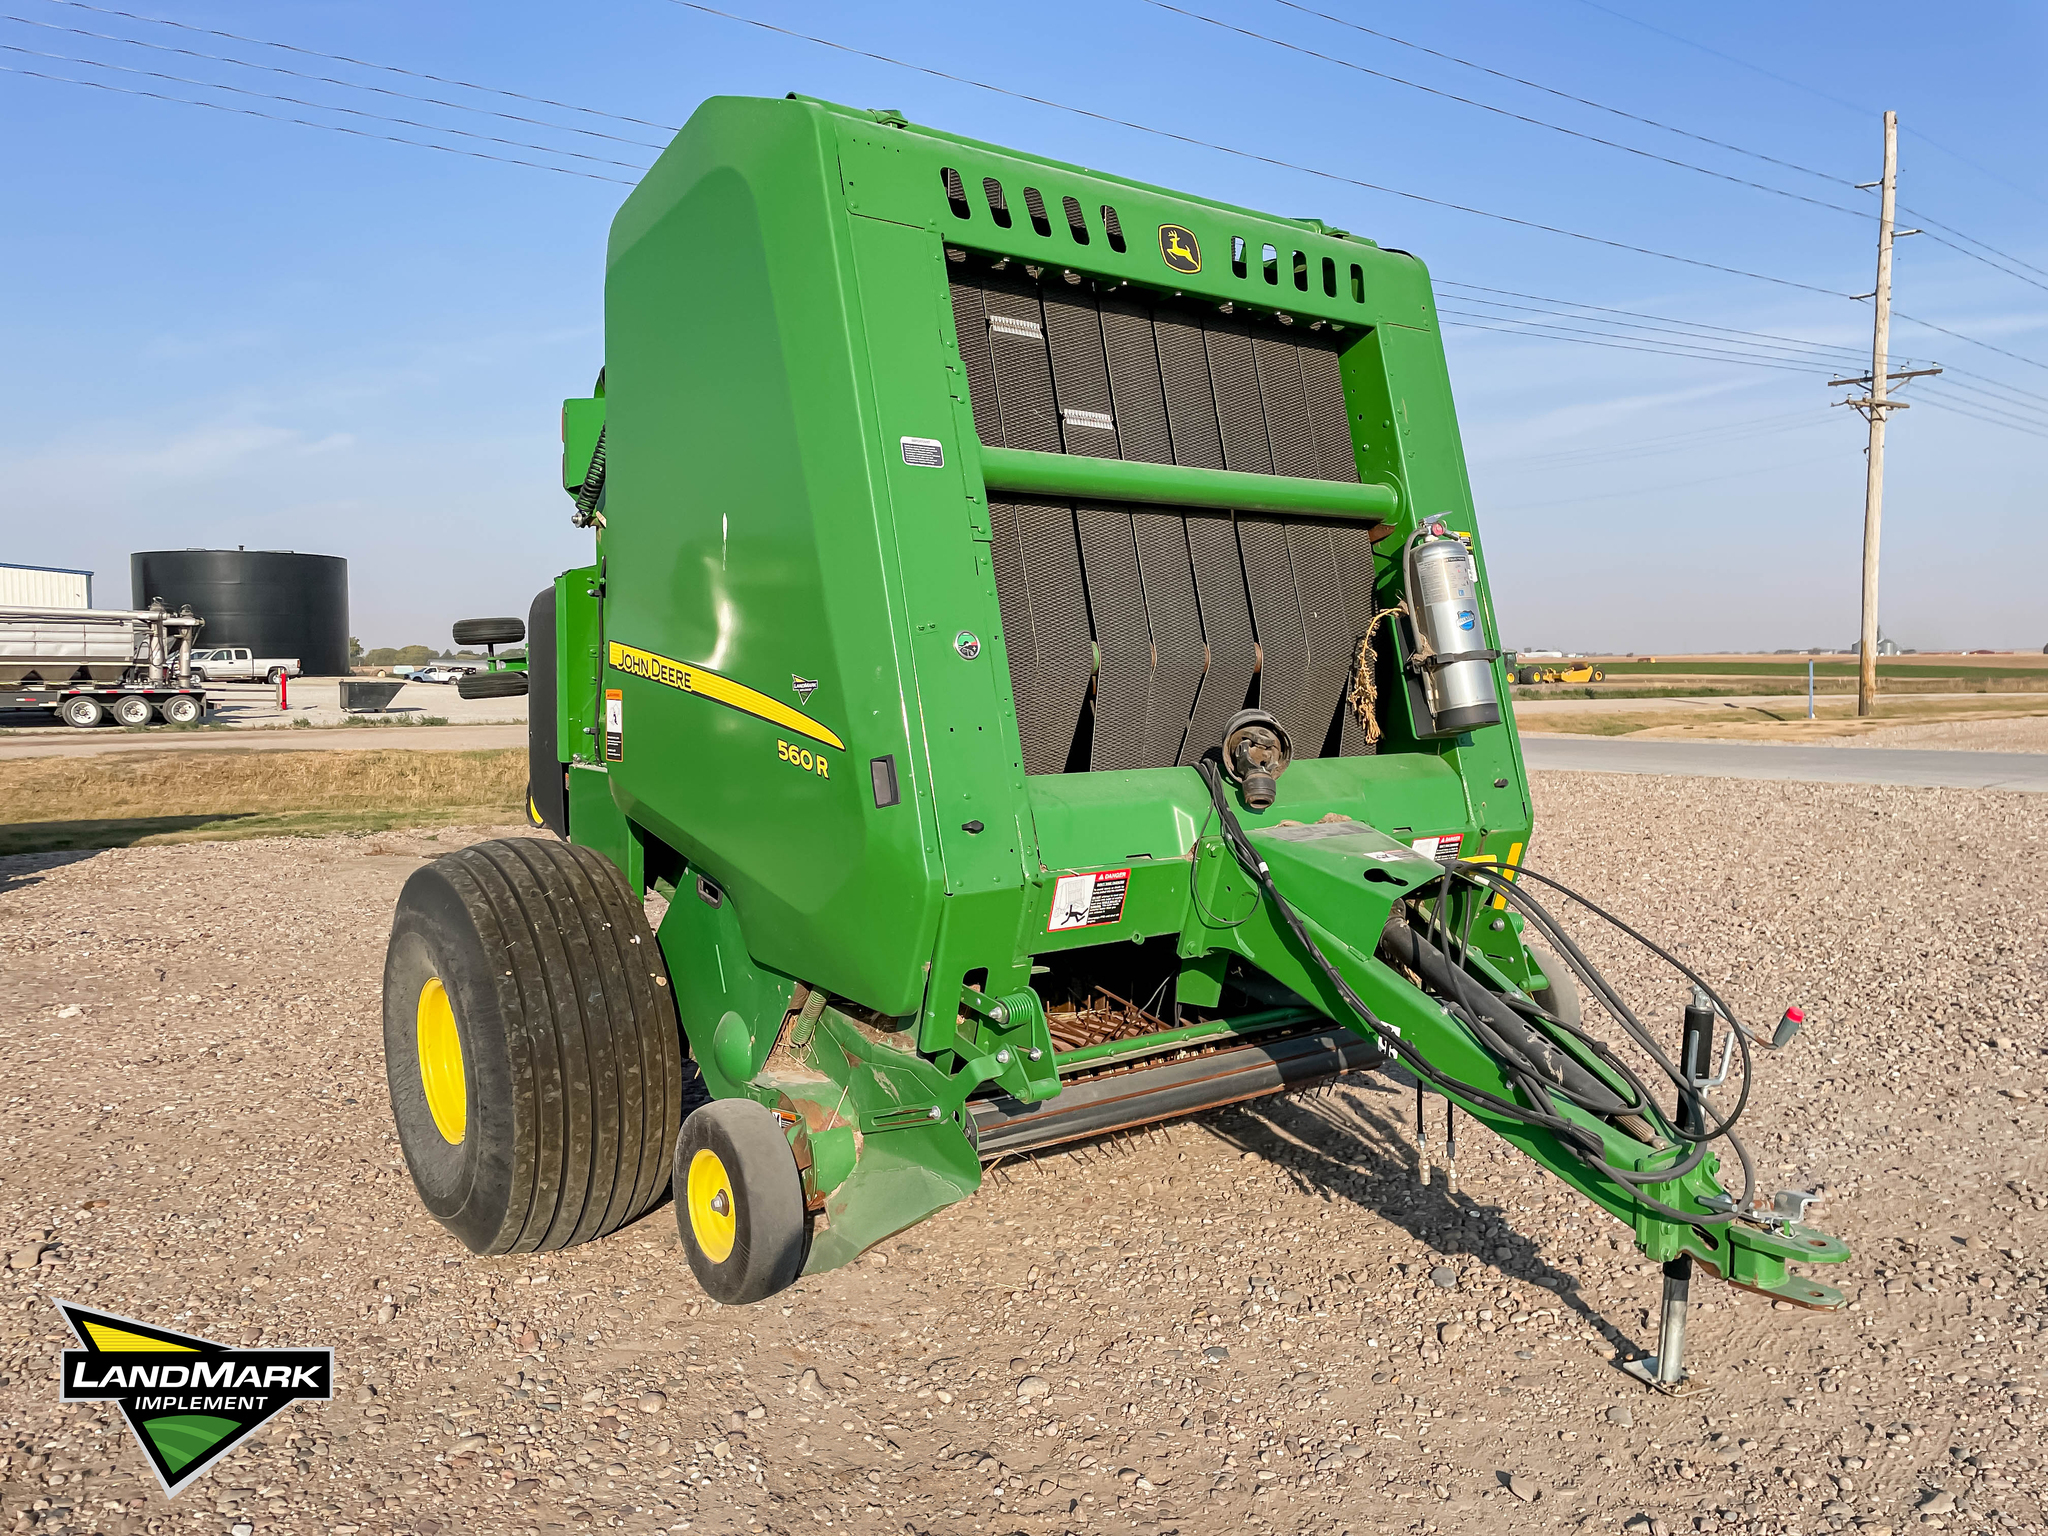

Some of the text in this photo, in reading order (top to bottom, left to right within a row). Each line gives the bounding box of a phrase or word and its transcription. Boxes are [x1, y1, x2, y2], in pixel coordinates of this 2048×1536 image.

[618, 650, 692, 689] JOHN DEERE
[777, 738, 830, 779] 560 R
